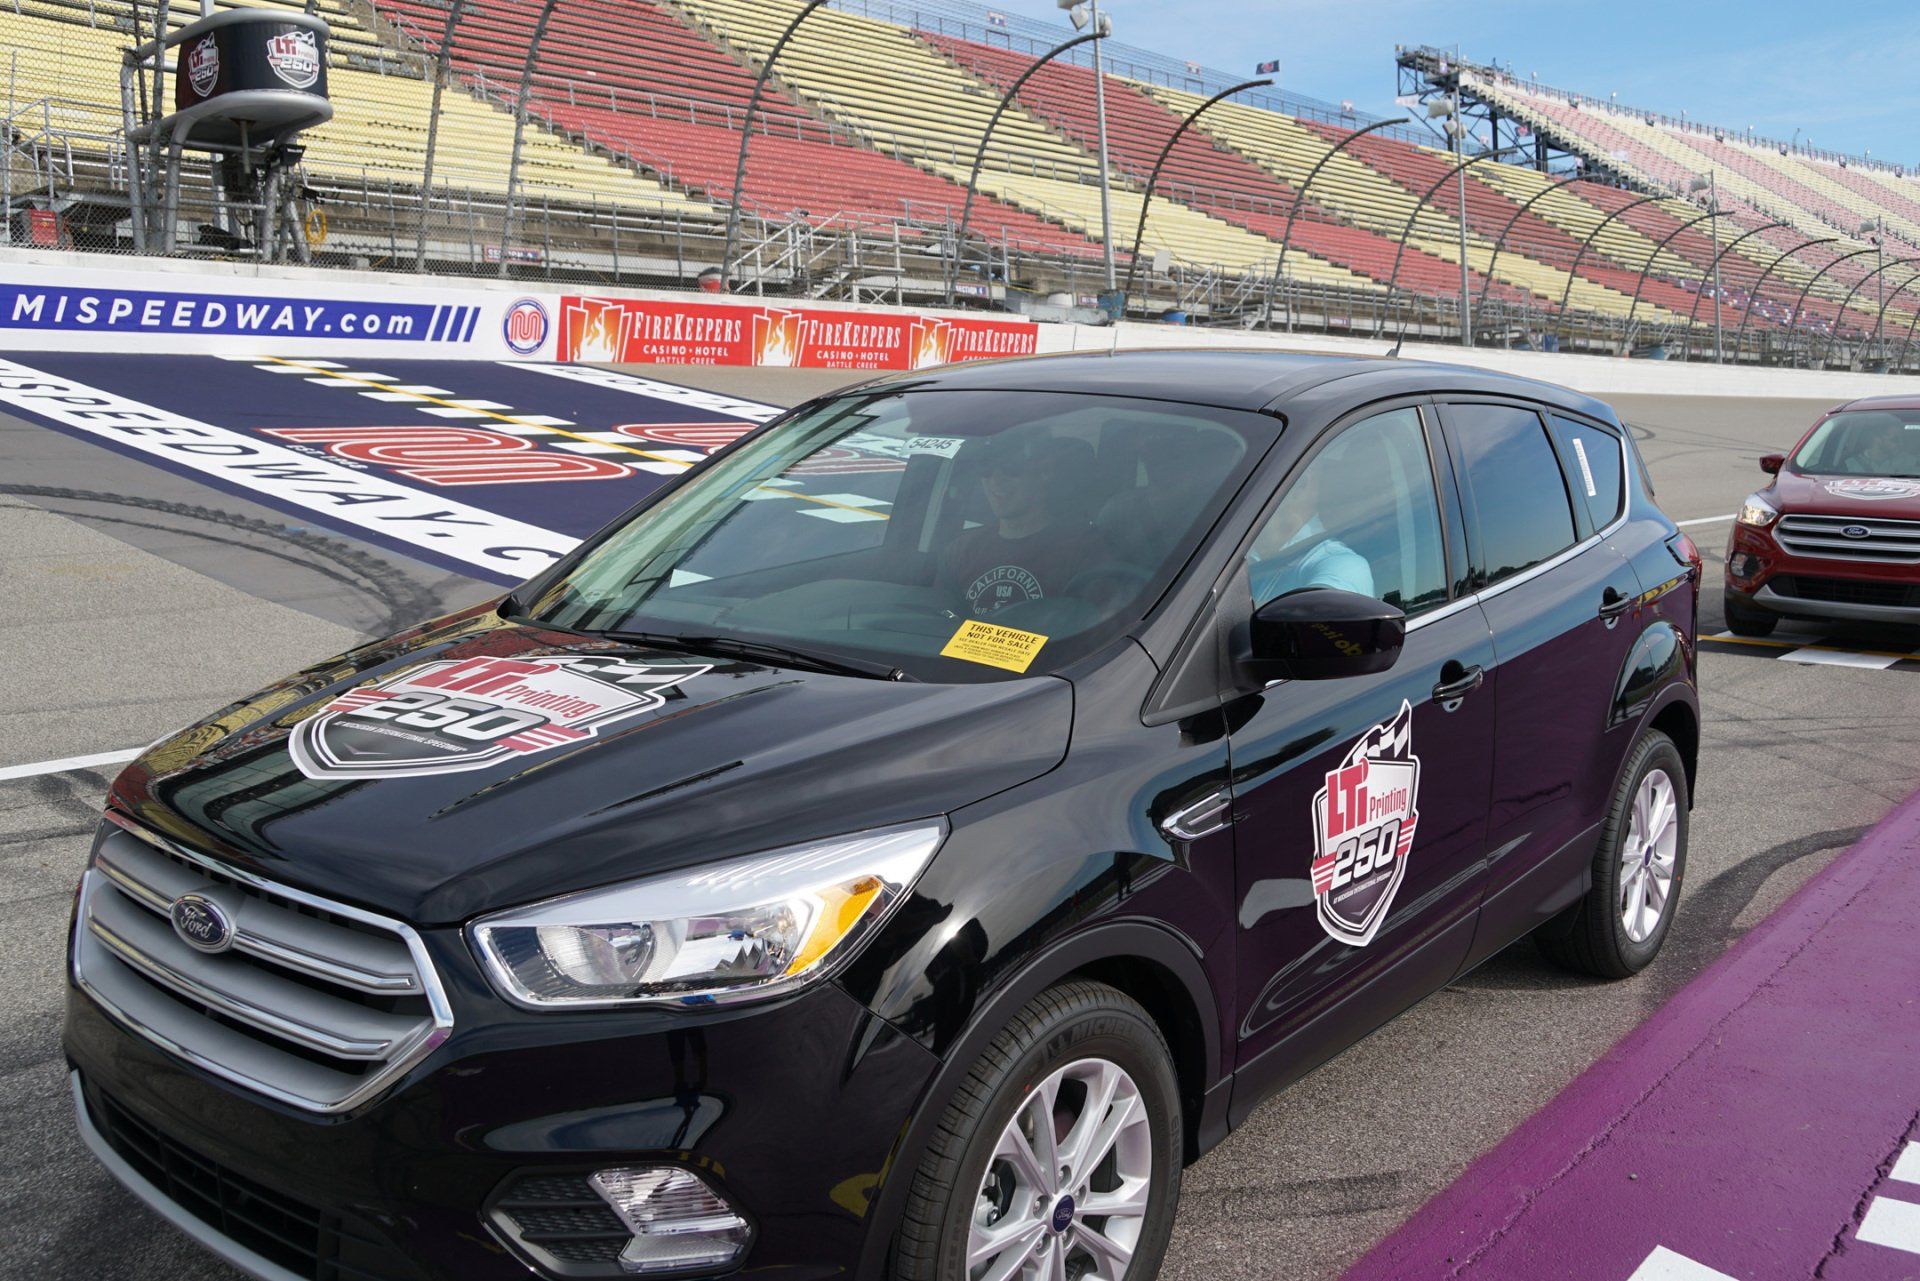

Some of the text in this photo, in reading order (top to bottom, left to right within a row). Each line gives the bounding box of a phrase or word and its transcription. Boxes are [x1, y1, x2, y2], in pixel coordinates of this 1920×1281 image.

[12, 294, 413, 335] MISPEEDWAY.com
[643, 344, 729, 357] CASINO HOTEL
[816, 350, 889, 361] CASINO HOTEL
[967, 568, 1041, 601] CALIFORNIA
[996, 585, 1013, 598] USA
[966, 631, 1032, 651] NOT FOR SALE
[970, 623, 1039, 645] THIS VEHICLE
[347, 692, 548, 741] 250
[495, 684, 603, 719] Printing
[1369, 787, 1407, 822] Printing
[1330, 819, 1402, 891] 250
[181, 906, 213, 938] Ford
